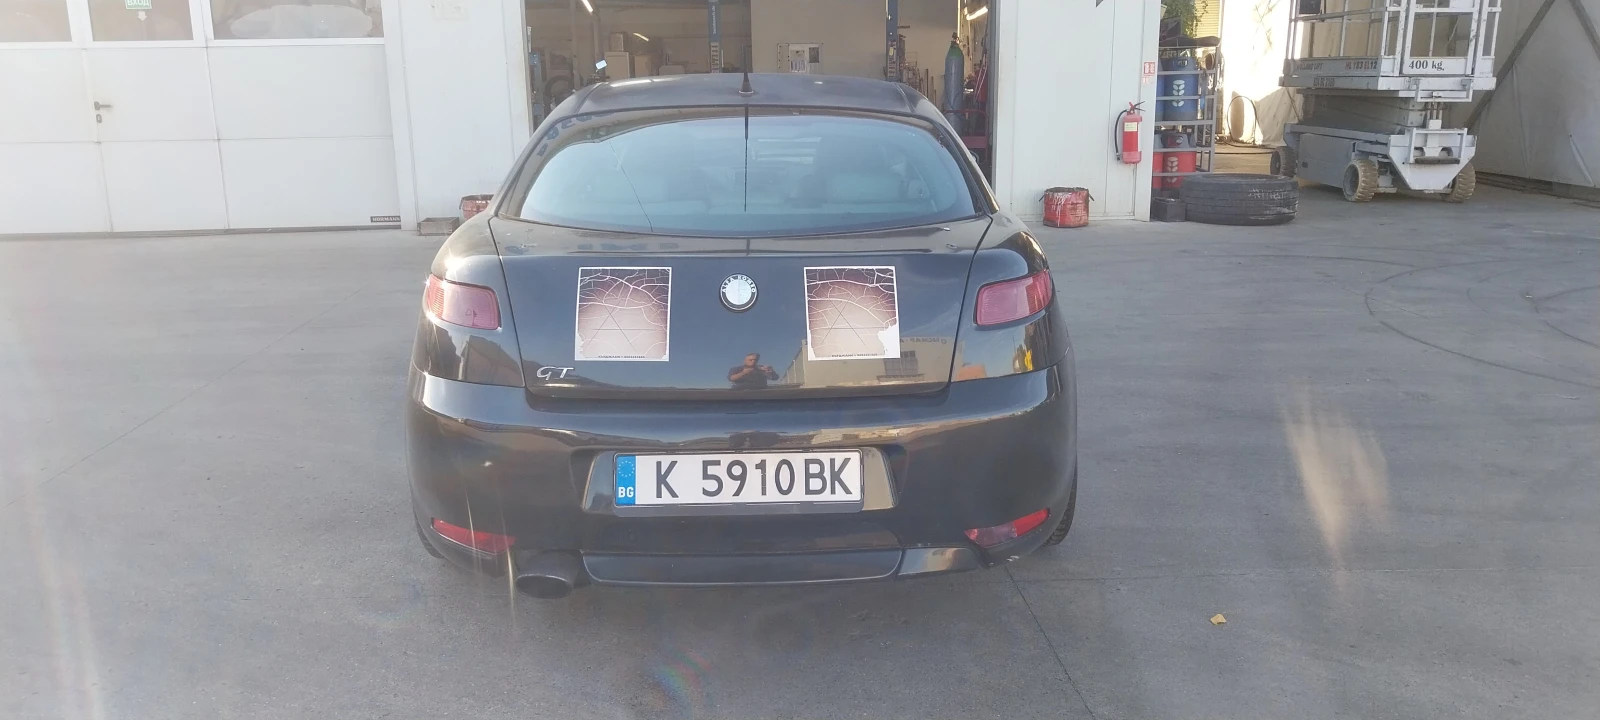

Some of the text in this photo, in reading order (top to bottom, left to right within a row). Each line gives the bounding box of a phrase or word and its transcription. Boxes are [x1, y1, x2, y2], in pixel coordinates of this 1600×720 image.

[1409, 60, 1428, 69] 400
[537, 366, 574, 381] GT
[656, 458, 853, 499] K 5910 BK
[618, 486, 634, 498] BG
